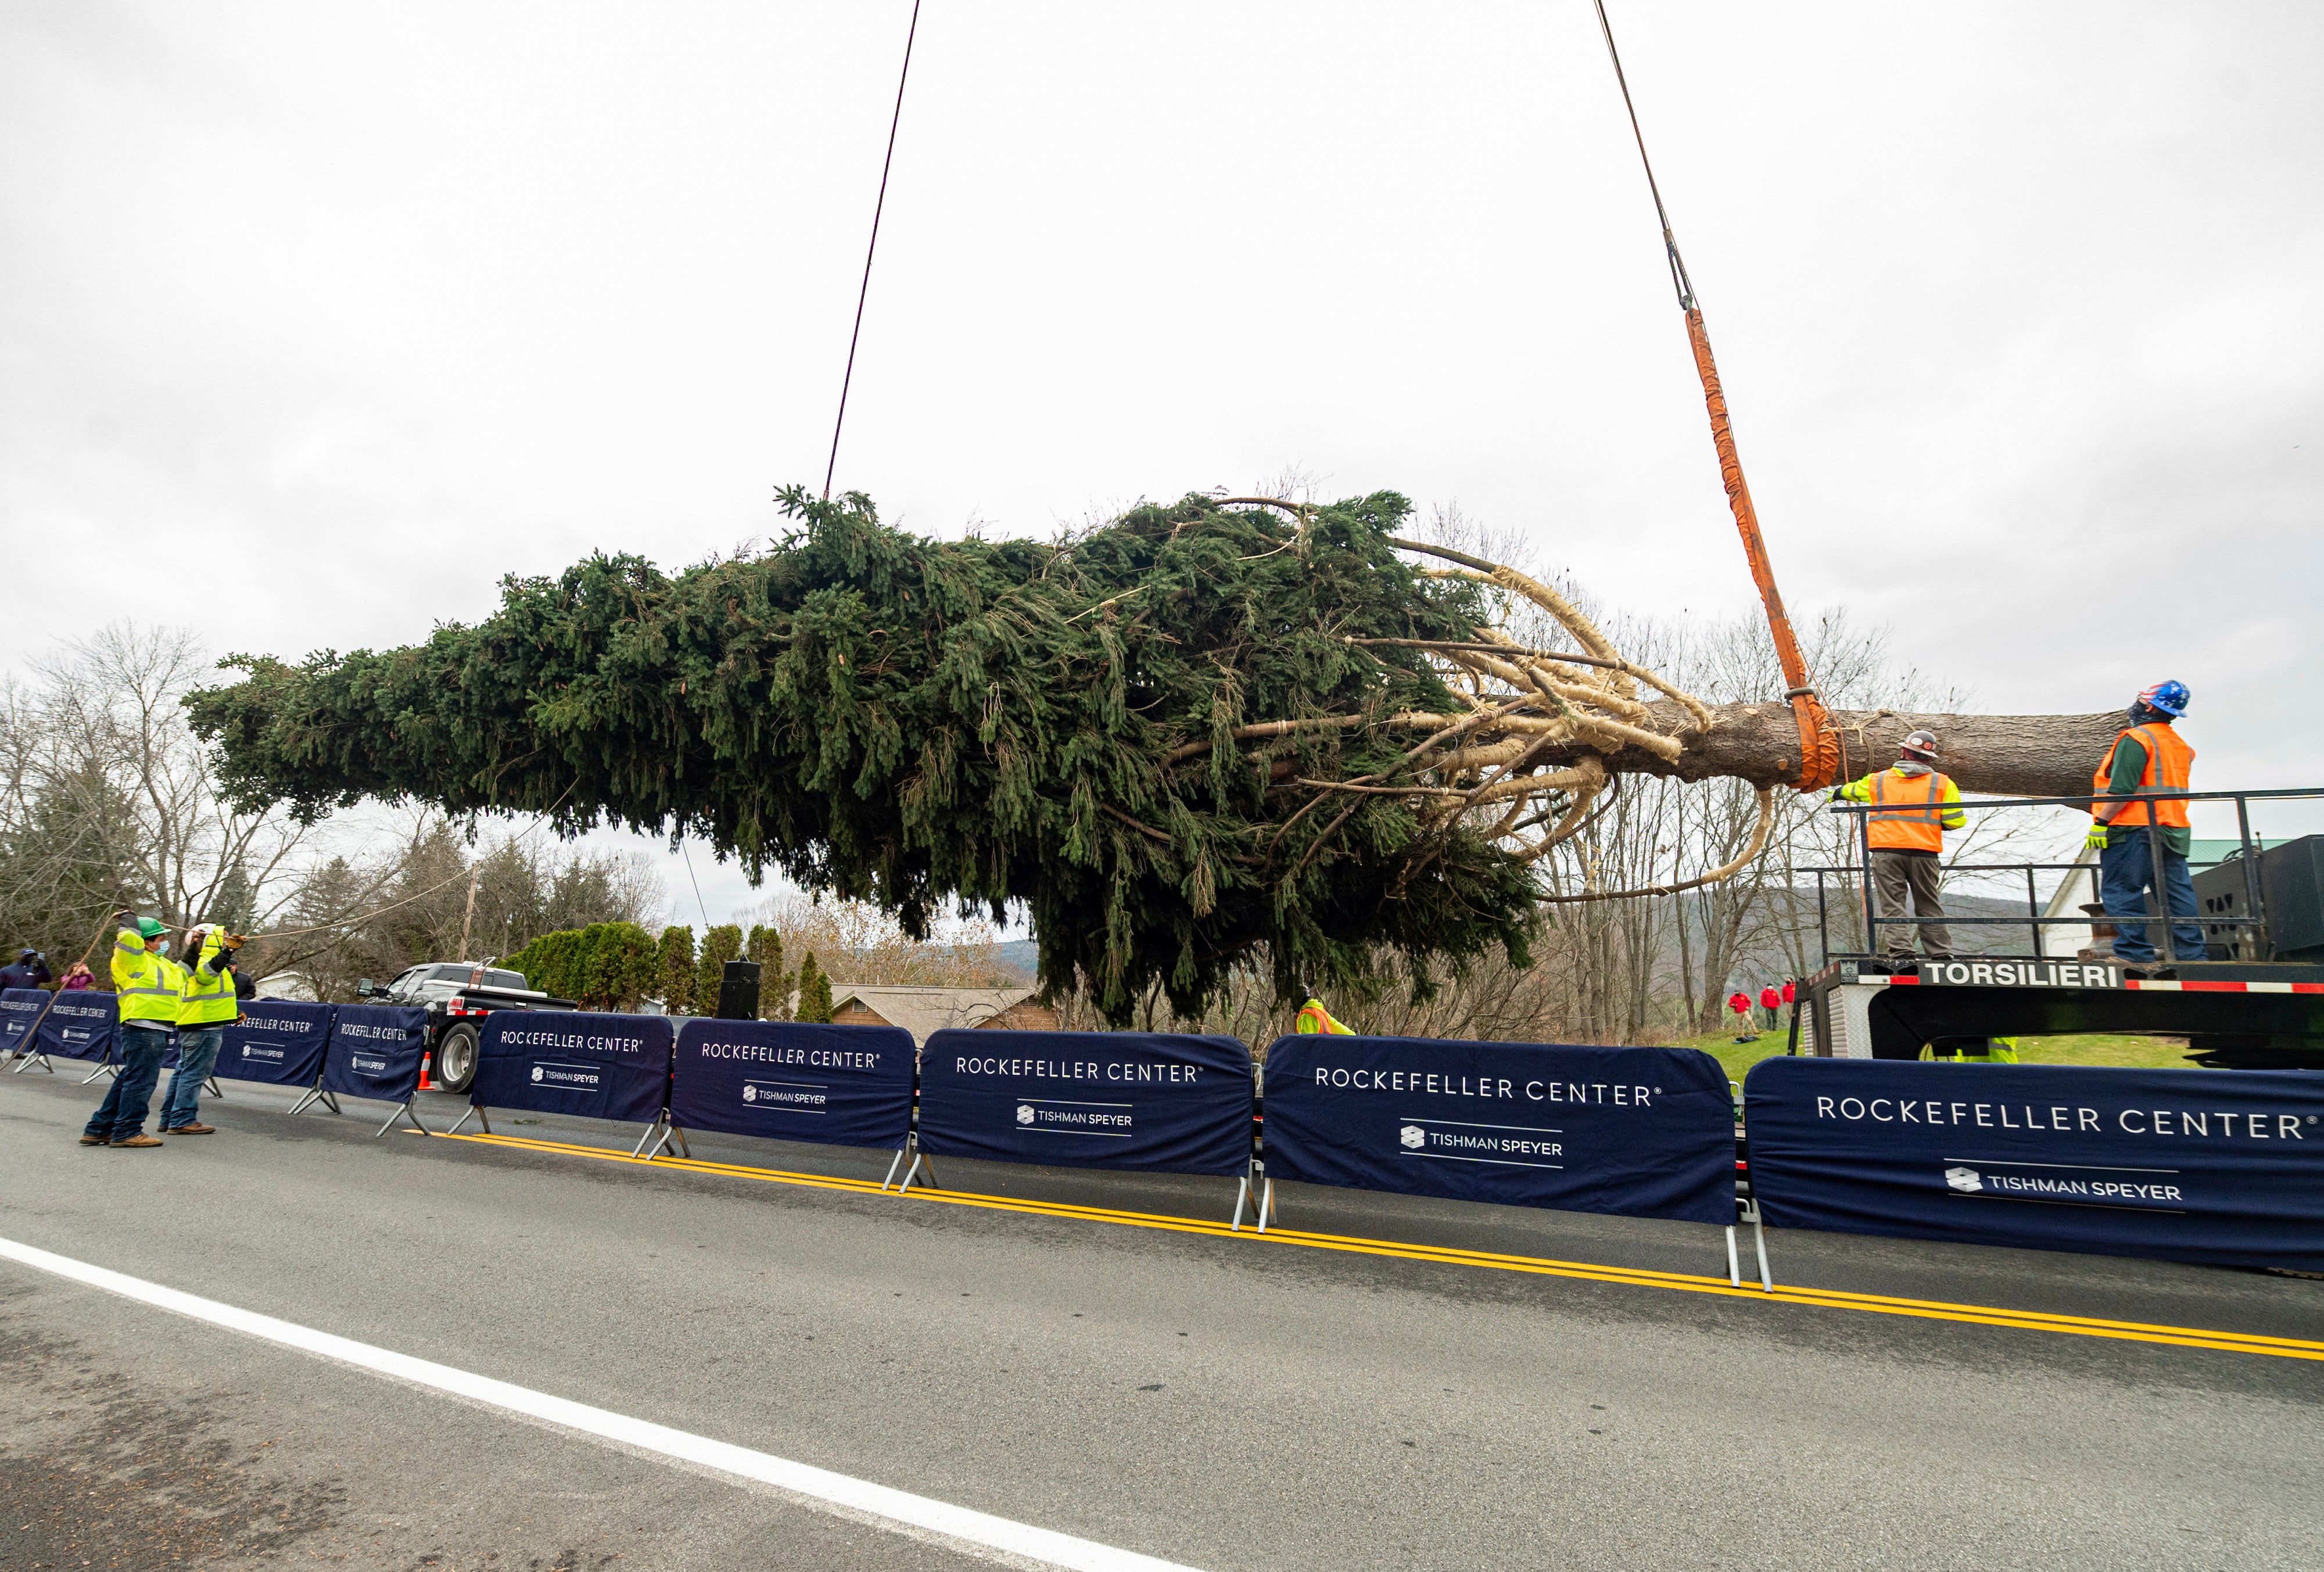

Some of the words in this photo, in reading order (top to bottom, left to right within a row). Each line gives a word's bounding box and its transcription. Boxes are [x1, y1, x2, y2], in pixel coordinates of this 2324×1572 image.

[1924, 963, 2118, 988] TORSILIERI
[340, 1023, 381, 1038] ROCKEFELLER
[381, 1027, 407, 1040] CENTER
[501, 1031, 583, 1049] ROCKEFELLER
[702, 1043, 805, 1064] ROCKEFELLER
[546, 1071, 573, 1081] TISHMAN
[573, 1074, 599, 1084] SPEYER
[956, 1057, 1098, 1080] ROCKEFELLER
[1316, 1067, 1513, 1099] ROCKEFELLER
[759, 1090, 794, 1101] TISHMAN
[794, 1093, 826, 1104] SPEYER
[1038, 1110, 1086, 1124] TISHMAN
[1088, 1114, 1132, 1127] SPEYER
[1816, 1096, 2102, 1132] ROCKEFELLER
[1429, 1132, 1498, 1151] TISHMAN
[1501, 1139, 1563, 1157] SPEYER
[1986, 1175, 2089, 1196] TISHMAN
[2091, 1182, 2183, 1201] SPEYER
